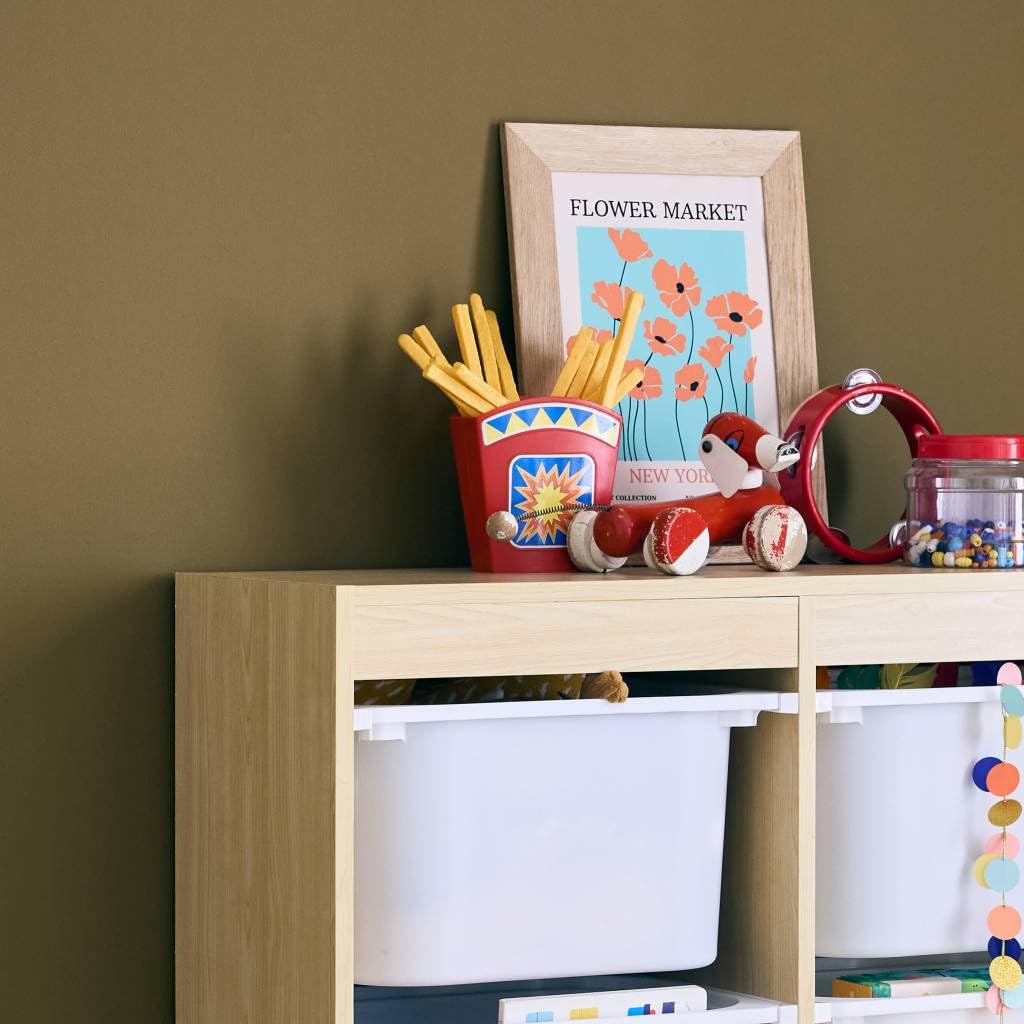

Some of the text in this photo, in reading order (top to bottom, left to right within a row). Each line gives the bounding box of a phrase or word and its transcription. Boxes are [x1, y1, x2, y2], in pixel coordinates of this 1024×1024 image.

[570, 198, 748, 222] FLOWER MARKET
[630, 468, 715, 484] NEW YOR
